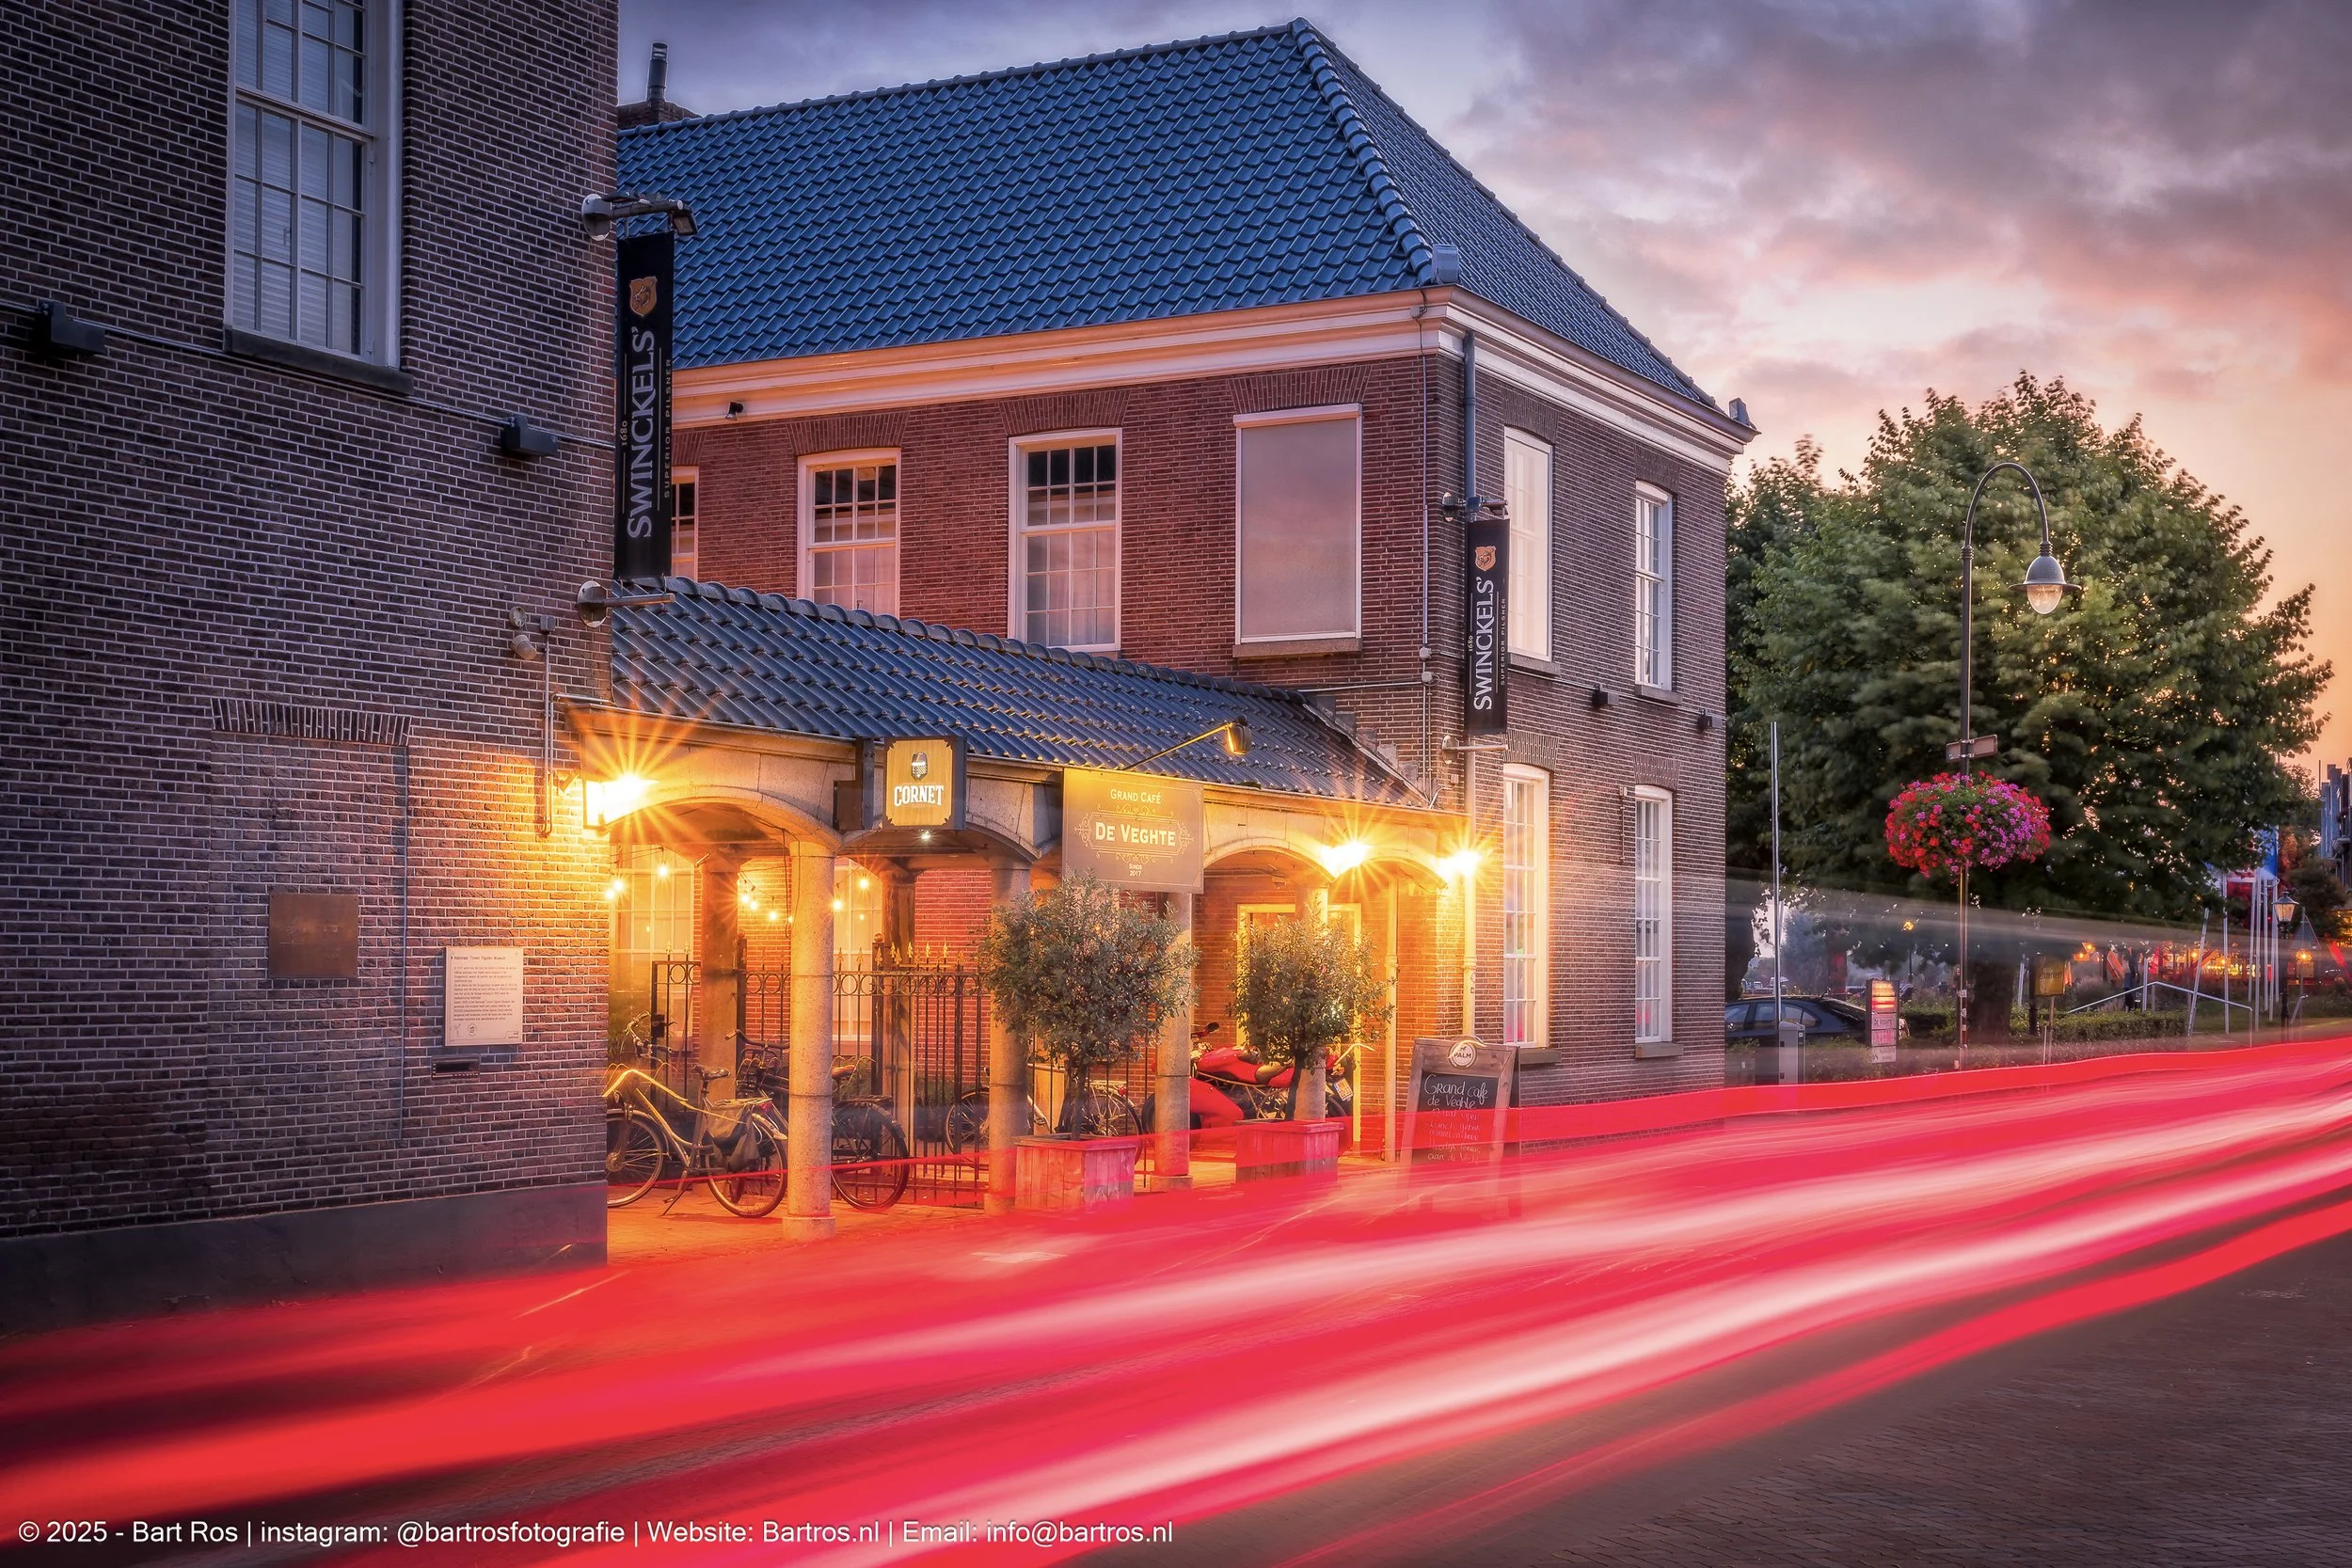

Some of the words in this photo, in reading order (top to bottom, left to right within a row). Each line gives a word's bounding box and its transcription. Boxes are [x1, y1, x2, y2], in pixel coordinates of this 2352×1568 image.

[627, 326, 656, 538] SWINCKELS'
[1473, 576, 1495, 710] SWINCKELS'
[894, 784, 945, 807] CORNET
[1110, 788, 1138, 802] GRAND
[1140, 791, 1162, 804] CAFÉ
[1095, 821, 1116, 842] DE
[1120, 823, 1176, 847] VEGHTE
[1427, 1095, 1440, 1106] de
